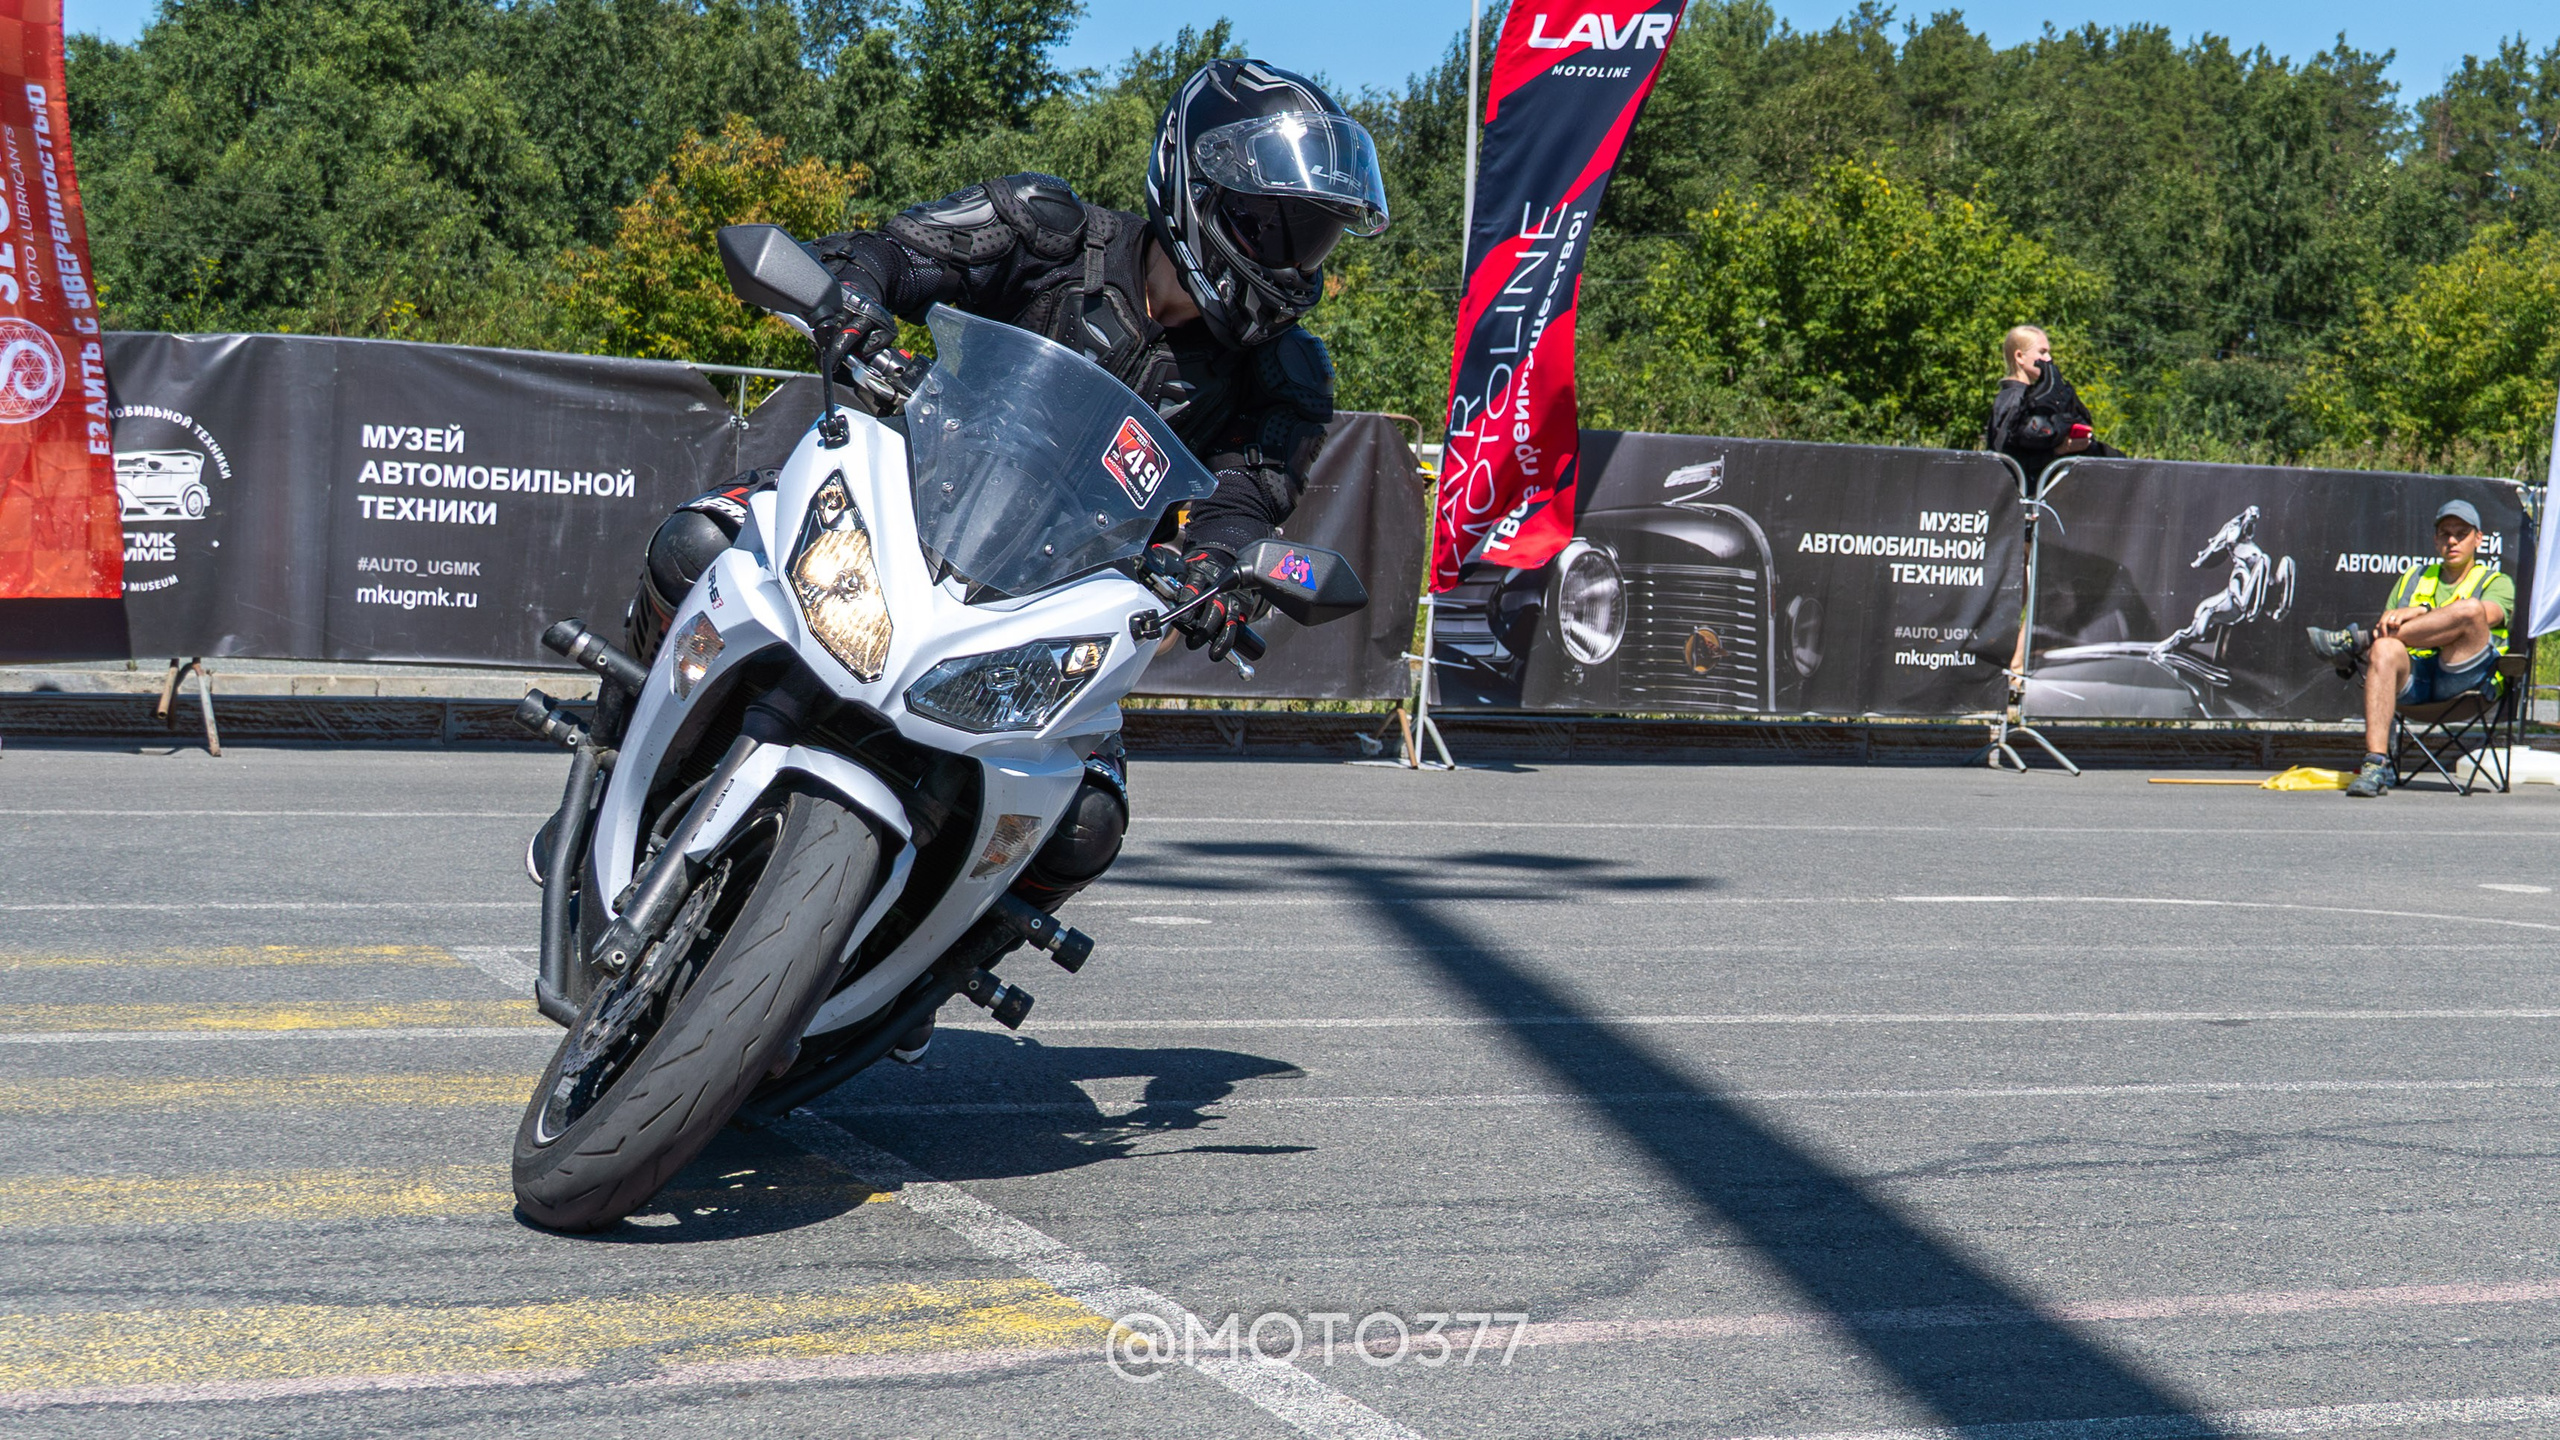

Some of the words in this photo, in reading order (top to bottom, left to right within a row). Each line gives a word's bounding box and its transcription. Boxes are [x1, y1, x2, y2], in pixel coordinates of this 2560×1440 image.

[1528, 13, 1673, 50] LAVR
[1551, 65, 1631, 79] MOTOLINE
[5, 125, 36, 243] LUBRICANTS
[26, 84, 96, 310] УВЕРЕННОСТЬЮ
[24, 245, 44, 303] MOTO
[80, 341, 112, 456] ЕЗДИТЬ
[109, 405, 193, 429] ОБИЛЬНОЙ
[194, 424, 232, 480] ТЕХНИКИ
[362, 424, 465, 454] МУЗЕЙ
[358, 460, 636, 498] АВТОМОБИЛЬНОЙ
[1124, 448, 1161, 493] 49
[358, 495, 498, 525] ТЕХНИКИ
[1919, 510, 1989, 534] МУЗЕЙ
[1798, 532, 1986, 561] АВТОМОБИЛЬНОЙ
[357, 557, 482, 578] #AUTO_UGMK
[1890, 563, 1984, 587] ТЕХНИКИ
[130, 574, 180, 592] MUSEUM
[357, 584, 478, 610] mkugmk.ru
[1895, 648, 1976, 671] mkugmk.ru
